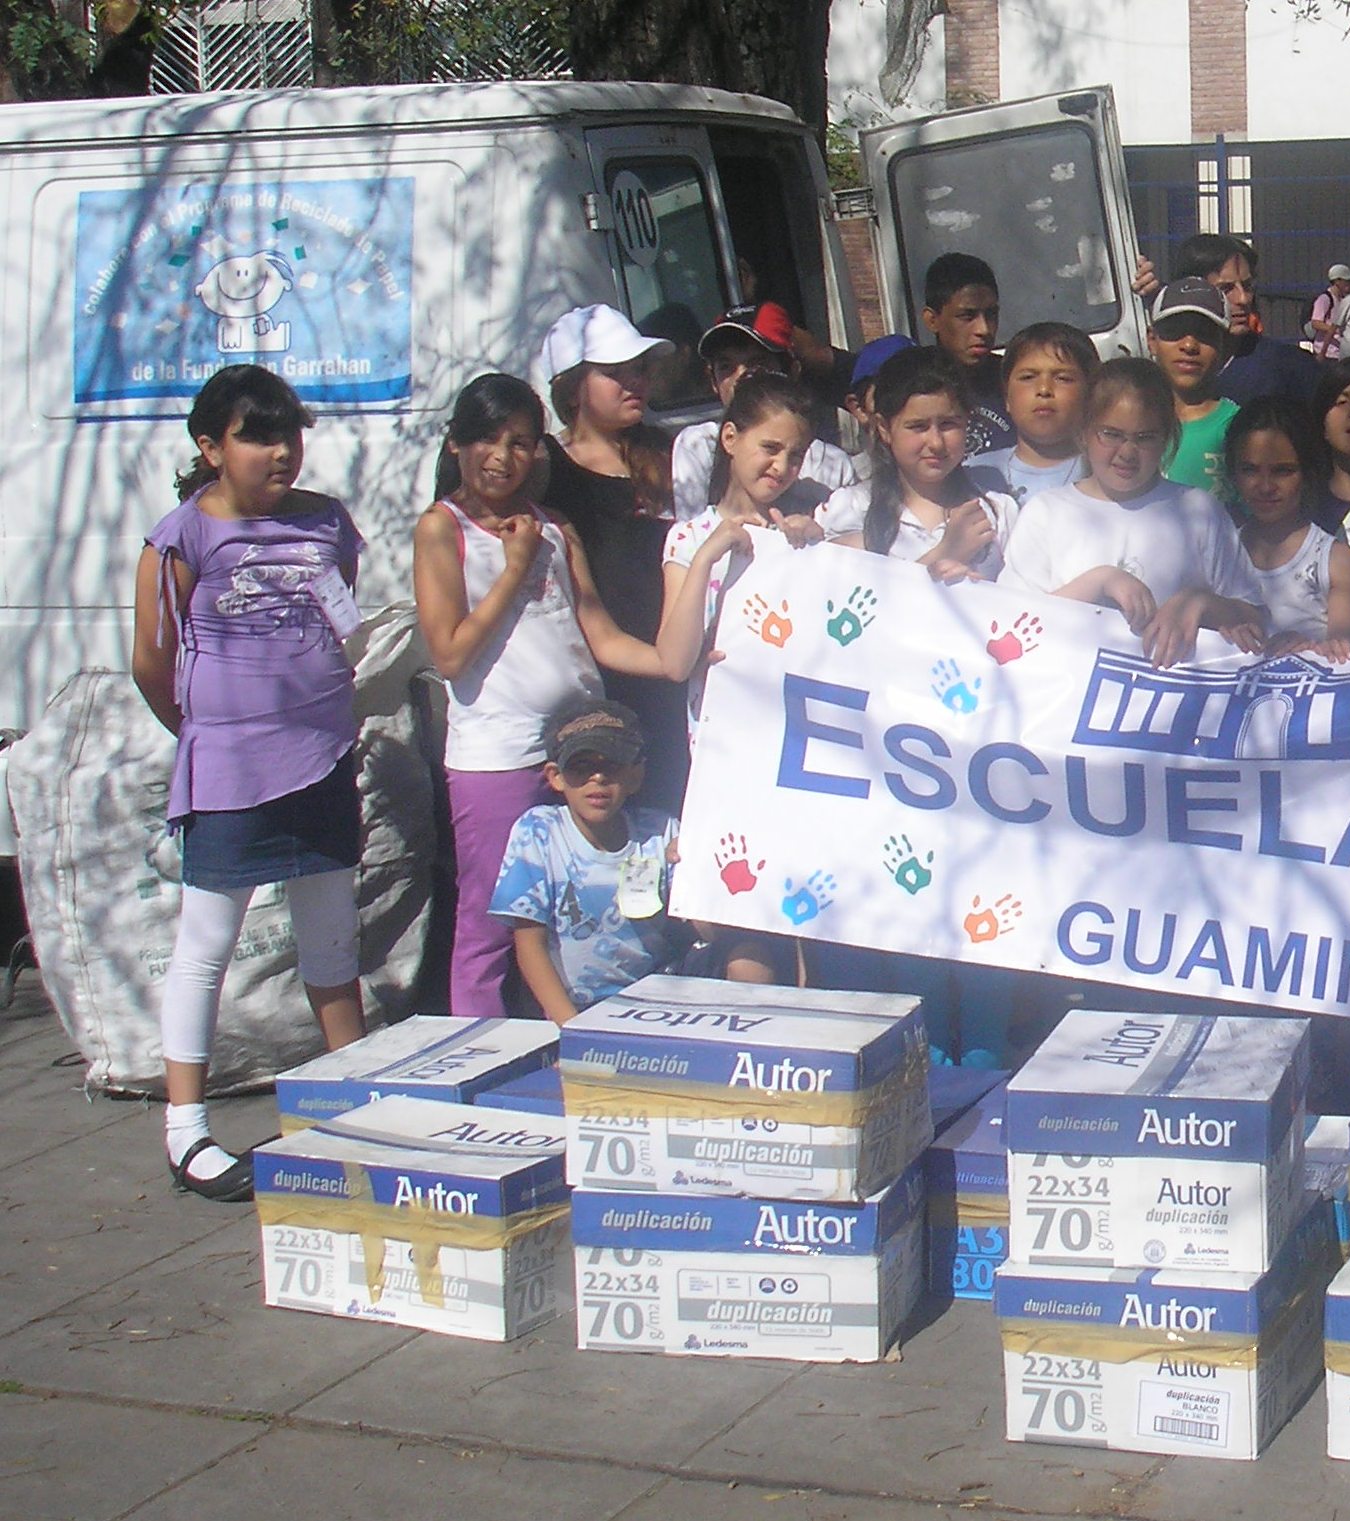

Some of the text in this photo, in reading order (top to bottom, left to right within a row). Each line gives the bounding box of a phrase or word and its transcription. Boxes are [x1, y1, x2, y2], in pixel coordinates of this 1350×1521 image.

[616, 188, 657, 249] 110
[131, 354, 371, 382] de la Fundión Garrahan
[606, 1007, 776, 1034] Autor
[582, 1047, 833, 1094] duplicación Autor
[1039, 1108, 1237, 1147] duplicación Autor
[578, 1133, 636, 1177] 70
[694, 1137, 814, 1166] duplicación
[394, 1175, 479, 1216] Autor
[1027, 1176, 1110, 1198] 22x34
[1157, 1178, 1232, 1207] Autor
[602, 1205, 859, 1246] duplicación Autor
[1026, 1207, 1093, 1252] 70
[1146, 1207, 1229, 1226] duplicación
[273, 1229, 334, 1252] 22x34
[957, 1226, 1004, 1254] A3
[274, 1255, 323, 1298] 70
[583, 1271, 660, 1294] 22x34
[953, 1258, 994, 1291] 80
[514, 1275, 546, 1318] 70
[582, 1299, 645, 1341] 70
[706, 1300, 834, 1325] duplicación
[1023, 1293, 1218, 1334] duplicación Autor
[703, 1339, 749, 1350] Ledesma
[1023, 1355, 1102, 1381] 22x34
[1022, 1386, 1086, 1433] 70
[1166, 1388, 1221, 1406] duplicación
[1182, 1402, 1219, 1415] BLANCO
